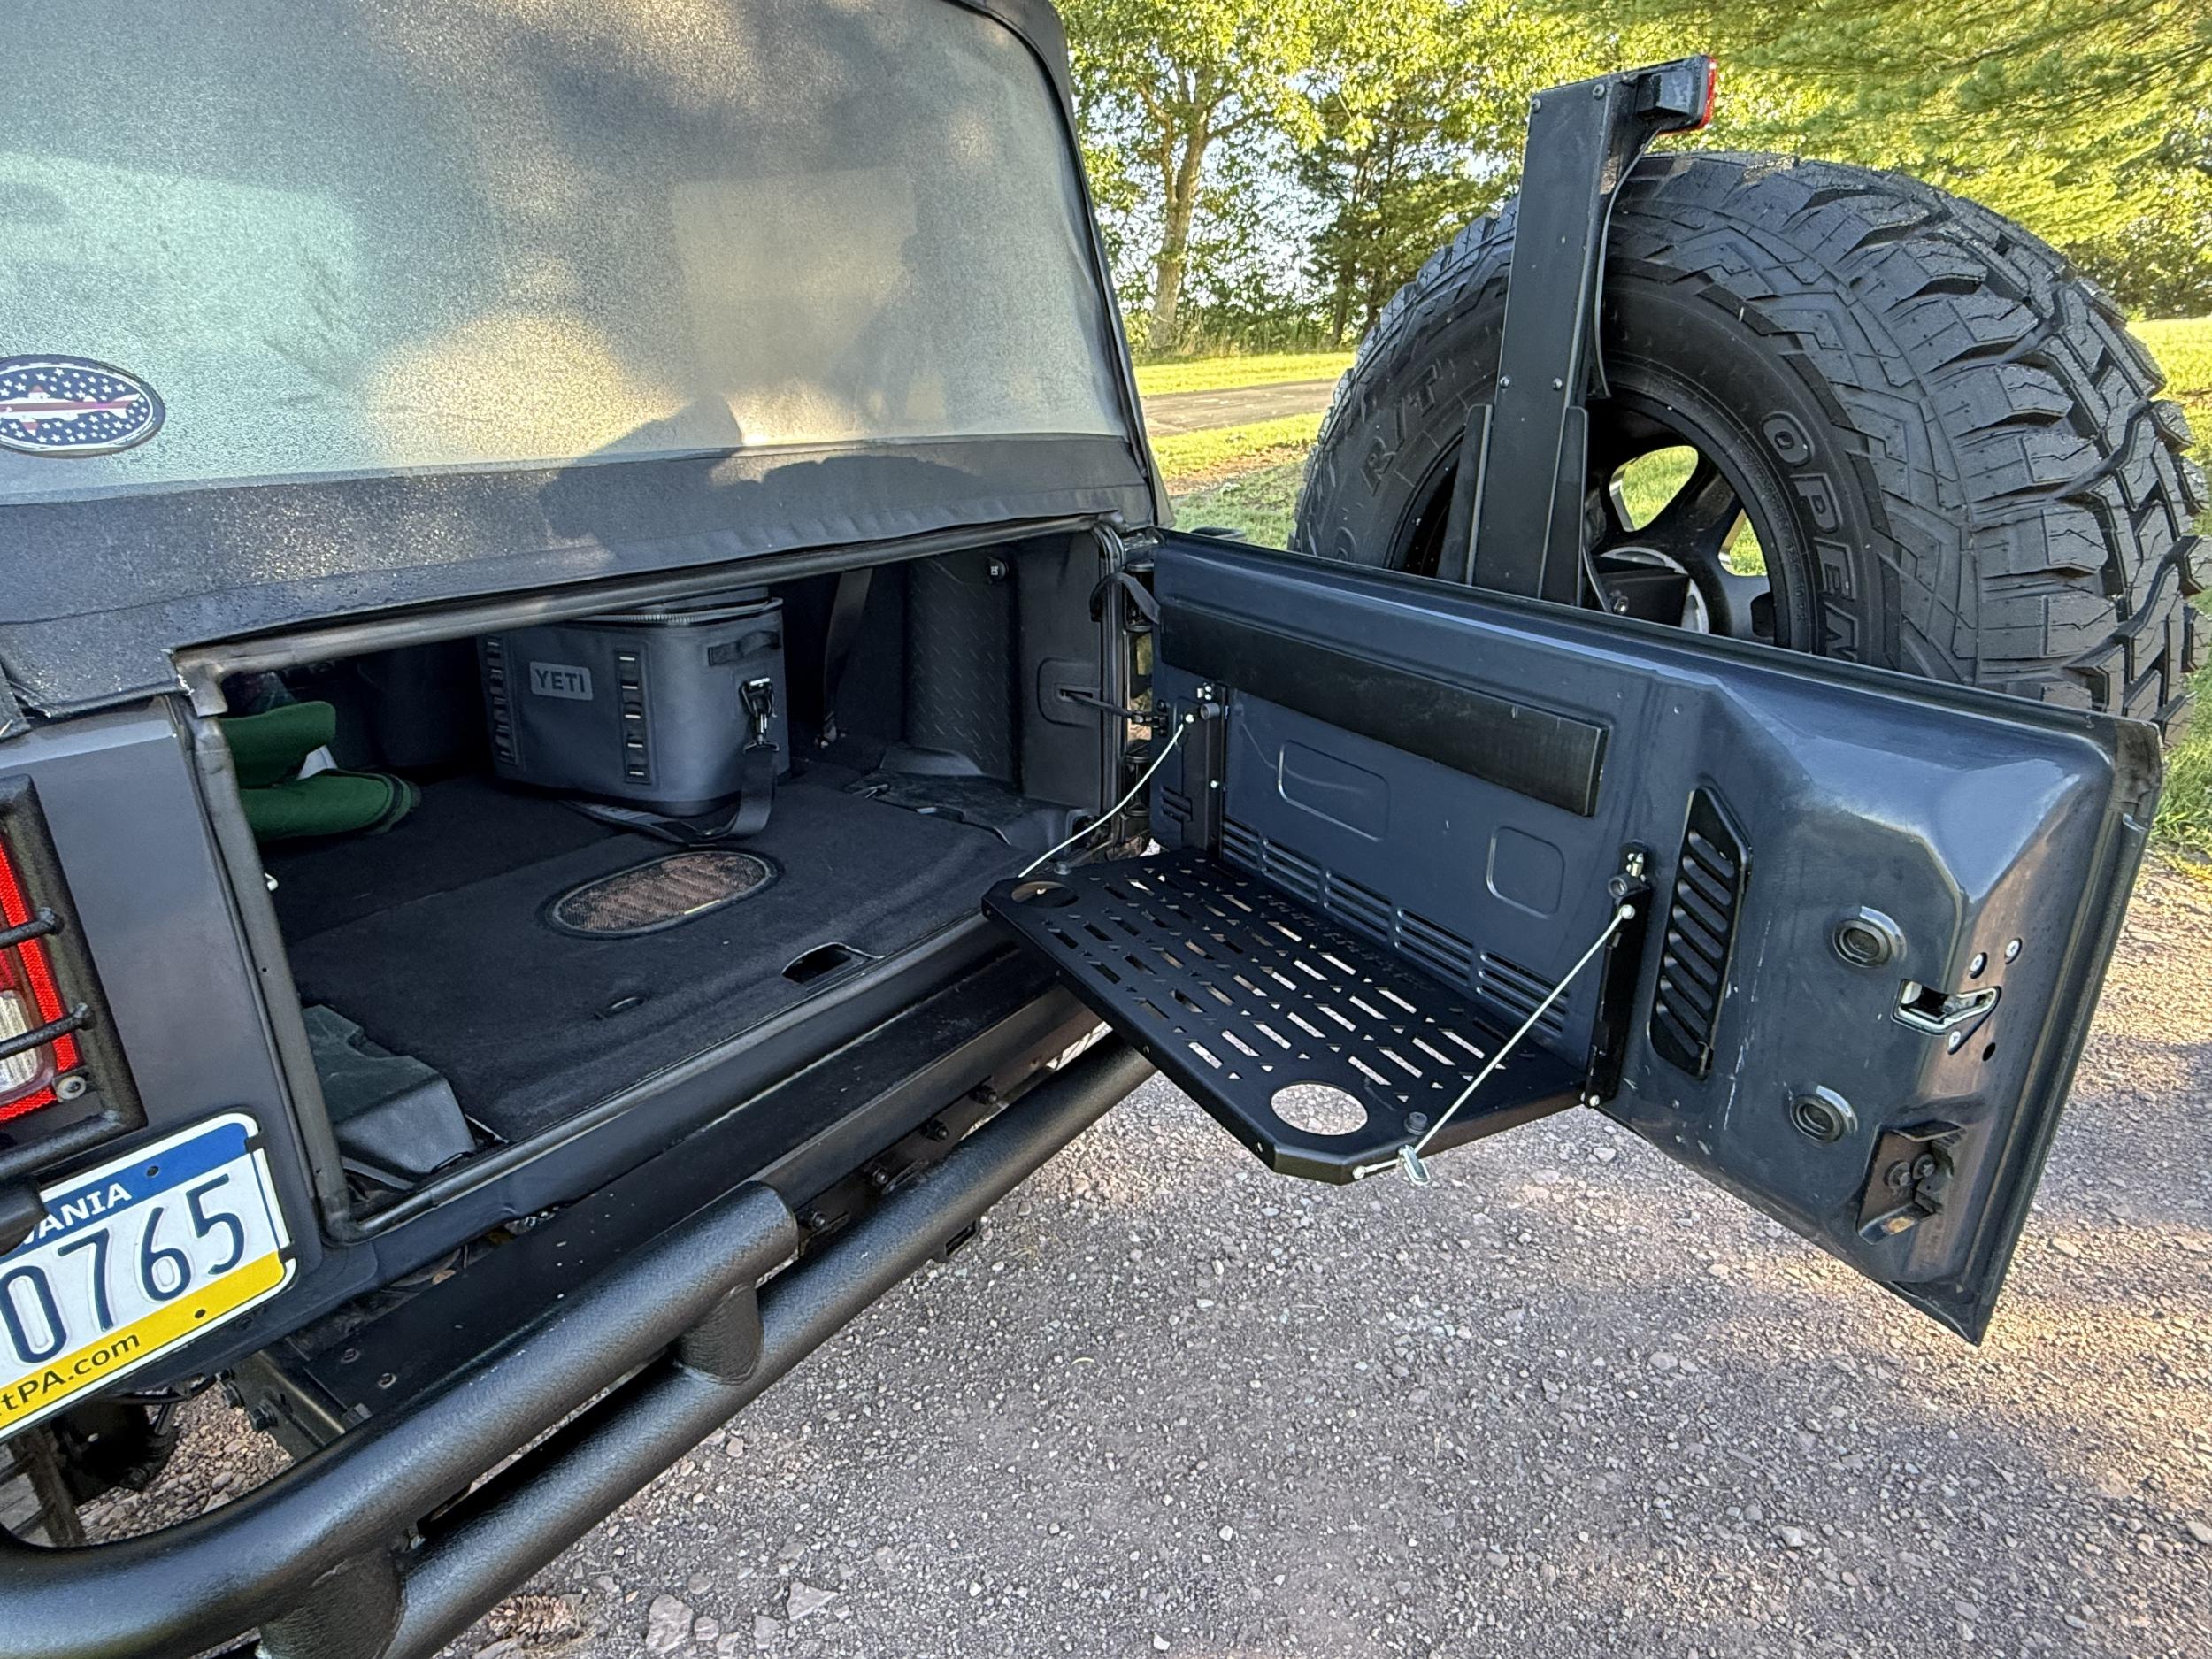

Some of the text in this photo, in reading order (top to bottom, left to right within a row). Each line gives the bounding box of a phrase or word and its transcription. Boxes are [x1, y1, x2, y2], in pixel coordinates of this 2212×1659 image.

[1762, 411, 1856, 660] OPEN
[534, 668, 586, 693] YETI
[1, 1172, 245, 1364] 0765
[0, 1334, 141, 1416] tPA.com
